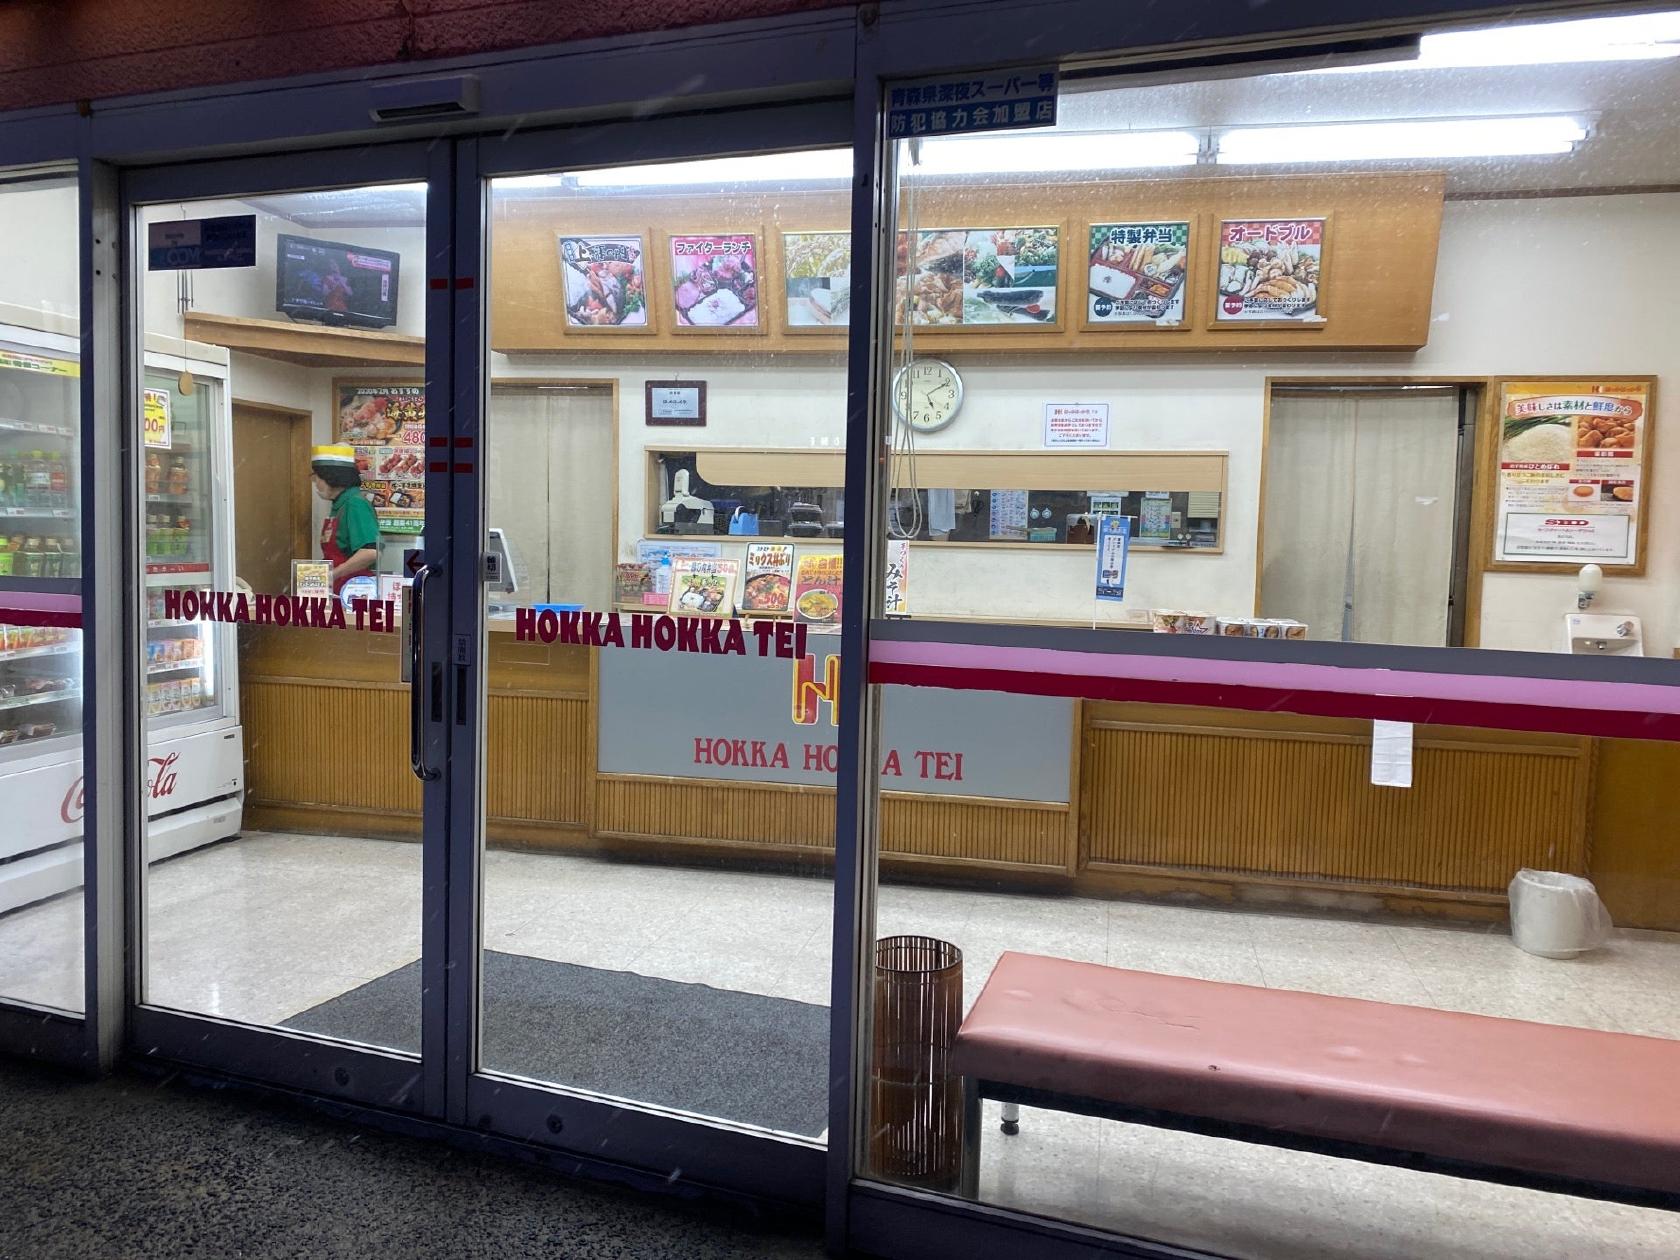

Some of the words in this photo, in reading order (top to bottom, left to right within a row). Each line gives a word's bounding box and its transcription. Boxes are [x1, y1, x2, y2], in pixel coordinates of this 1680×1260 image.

[890, 101, 1052, 133] 防犯協力会加盟店
[1110, 228, 1173, 244] 特製弁当
[1229, 224, 1312, 242] オードブル
[675, 241, 752, 255] ファイターランチ
[924, 367, 932, 375] 12
[938, 369, 942, 378] 1
[948, 390, 955, 398] 3
[944, 402, 950, 410] 4
[1515, 399, 1633, 416] 美味しさは素材と鮮度から
[913, 411, 919, 420] 7
[936, 411, 942, 419] 5
[144, 417, 165, 433] 00円
[749, 552, 791, 566] ミックス丼ぶり
[886, 563, 903, 611] みそ汁
[165, 590, 250, 623] HOKKA
[256, 594, 347, 629] HOKKA
[352, 598, 395, 632] TEI
[515, 608, 625, 648] HOKKA
[631, 614, 747, 656] HOKKA
[753, 620, 808, 660] TEI
[694, 738, 790, 769] HOKKA
[803, 744, 903, 776] HOA
[914, 750, 963, 781] TEI
